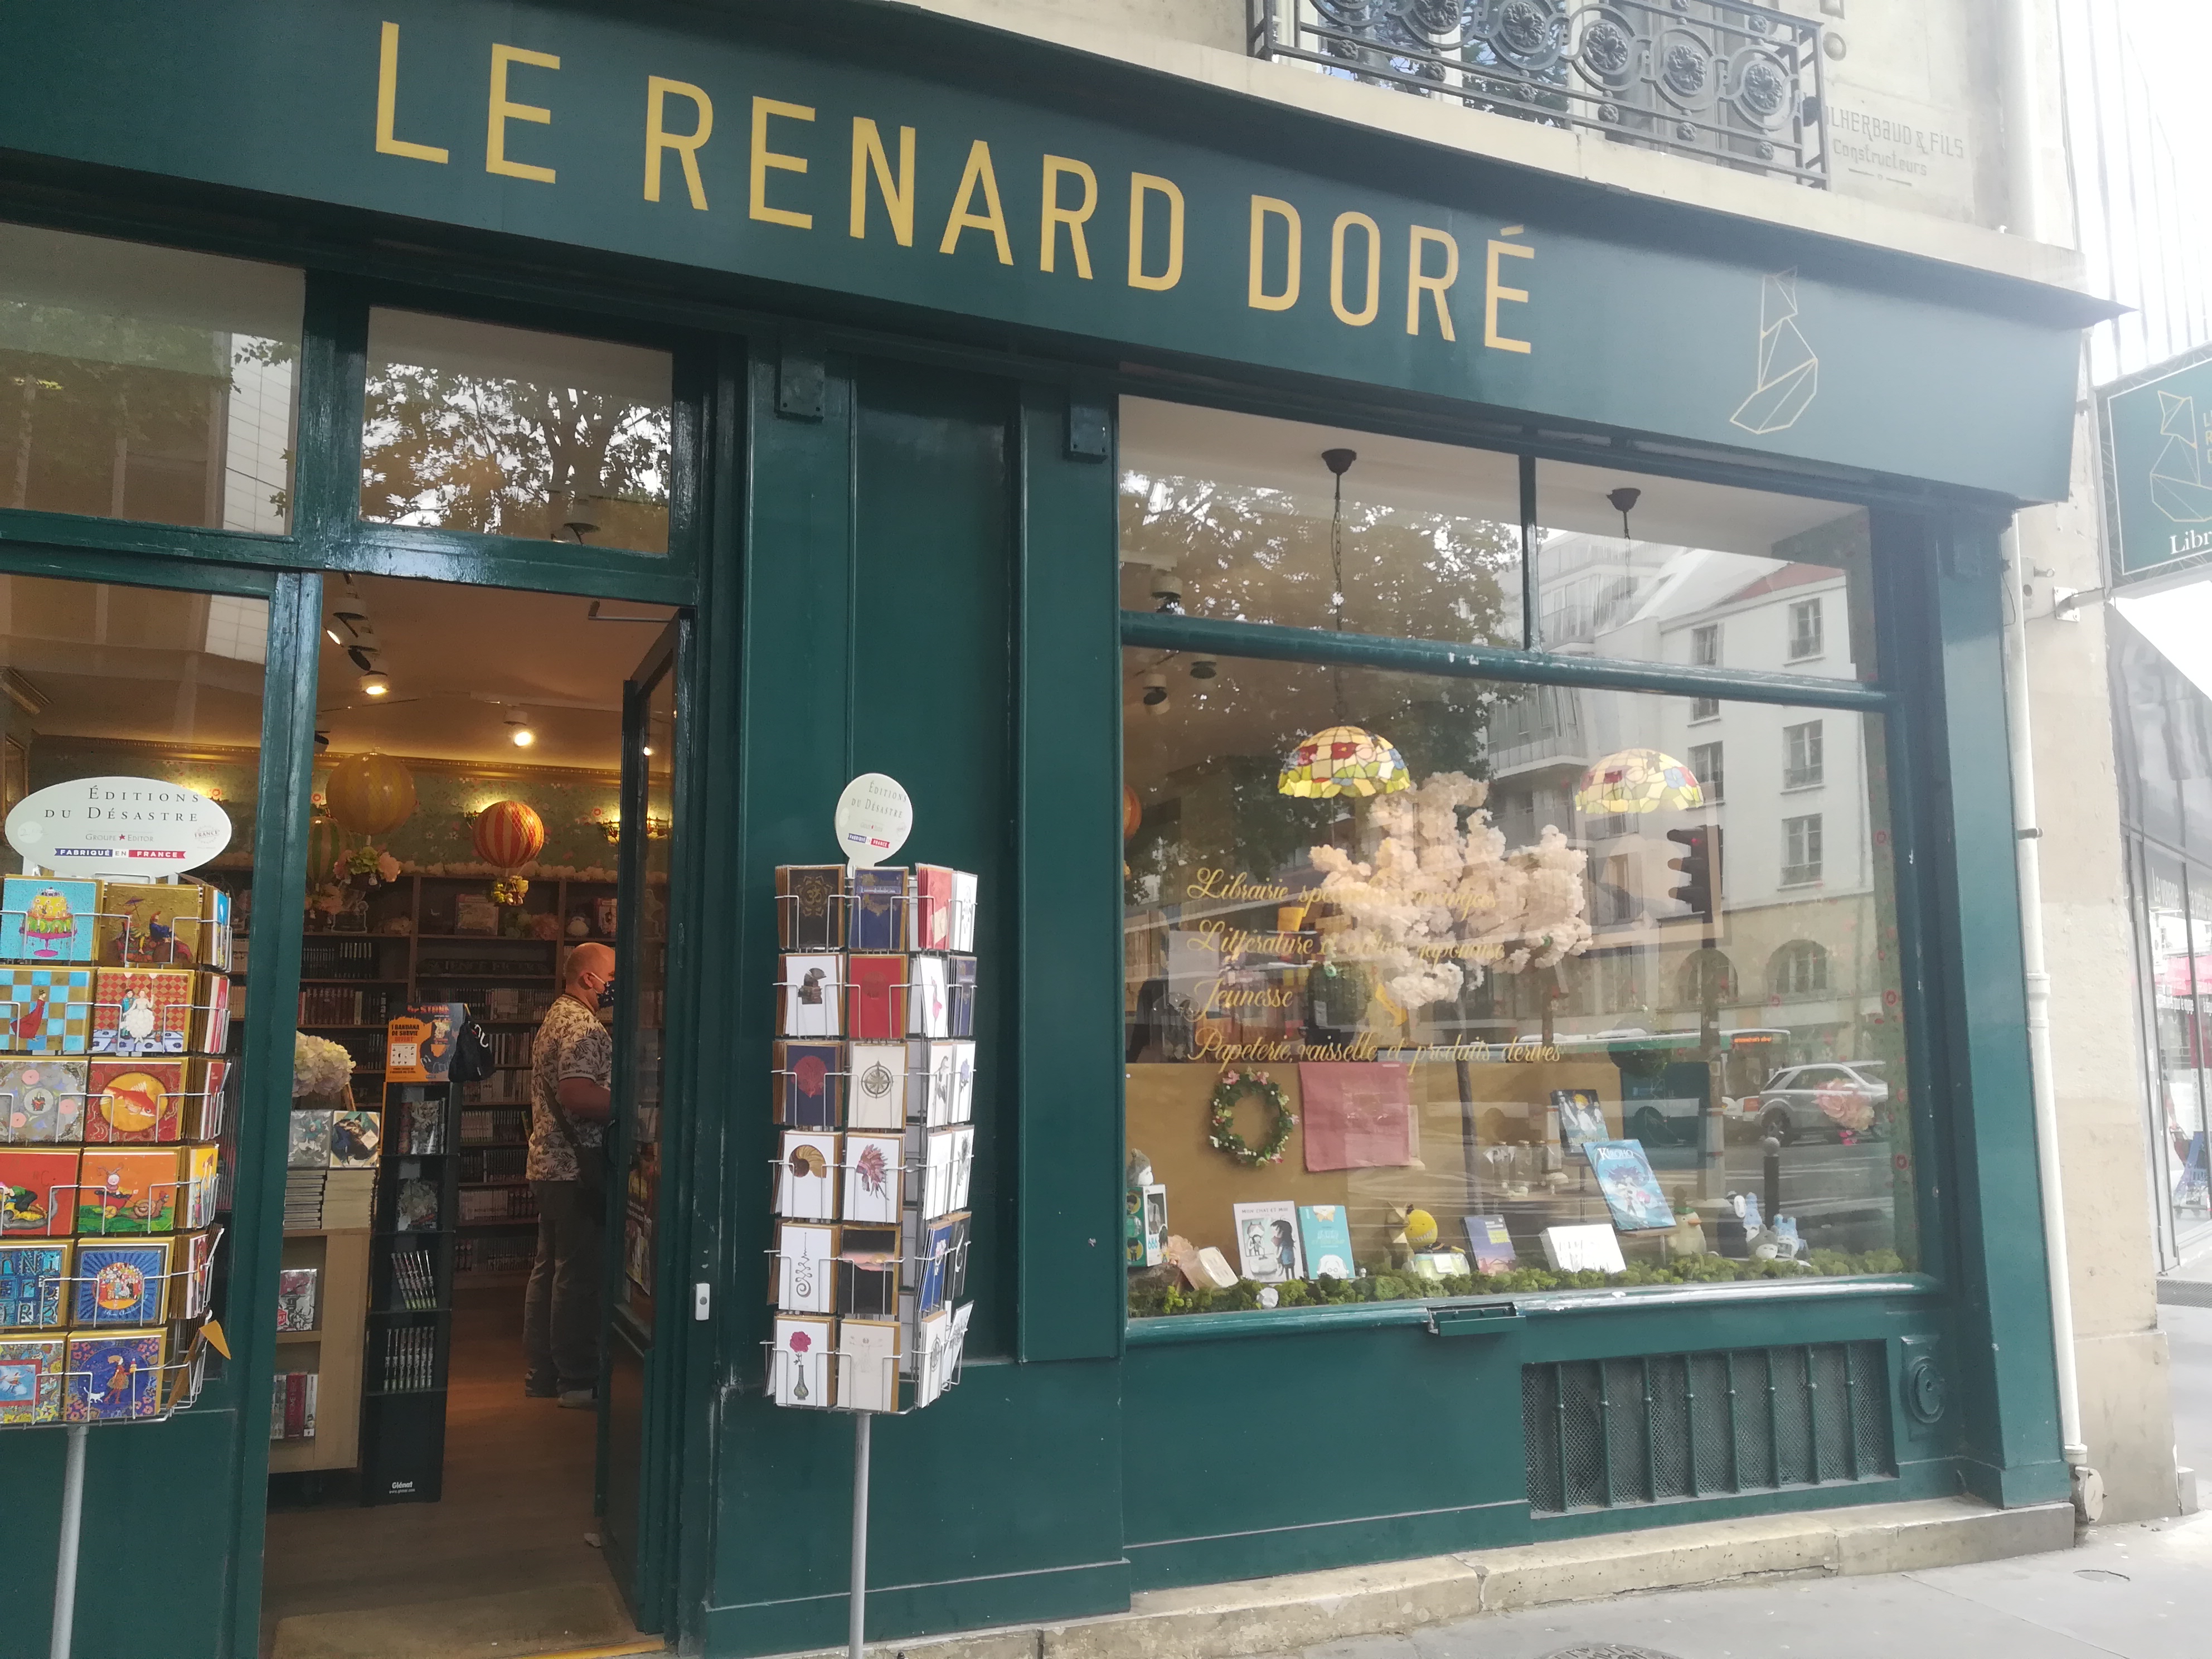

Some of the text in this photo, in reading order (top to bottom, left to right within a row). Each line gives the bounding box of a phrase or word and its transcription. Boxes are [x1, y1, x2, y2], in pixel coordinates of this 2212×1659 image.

[1826, 105, 1912, 145] LHERBAUD
[1832, 138, 1927, 176] Constructeurs
[375, 21, 1535, 354] LE RENARD DORÉ
[88, 784, 199, 803] ÉDITIONS
[851, 798, 861, 808] DU
[44, 807, 198, 822] DU DÉSASTRE
[85, 833, 154, 842] GROUPE EDITOR
[60, 848, 110, 857] FABRIQUÉ
[1187, 867, 1289, 900] Librairie
[1183, 977, 1293, 1023] Jeunesse
[1298, 1031, 1378, 1062] vaisselle
[1386, 1037, 1405, 1061] et
[1408, 1035, 1491, 1076] produits
[392, 1481, 413, 1489] Glénat
